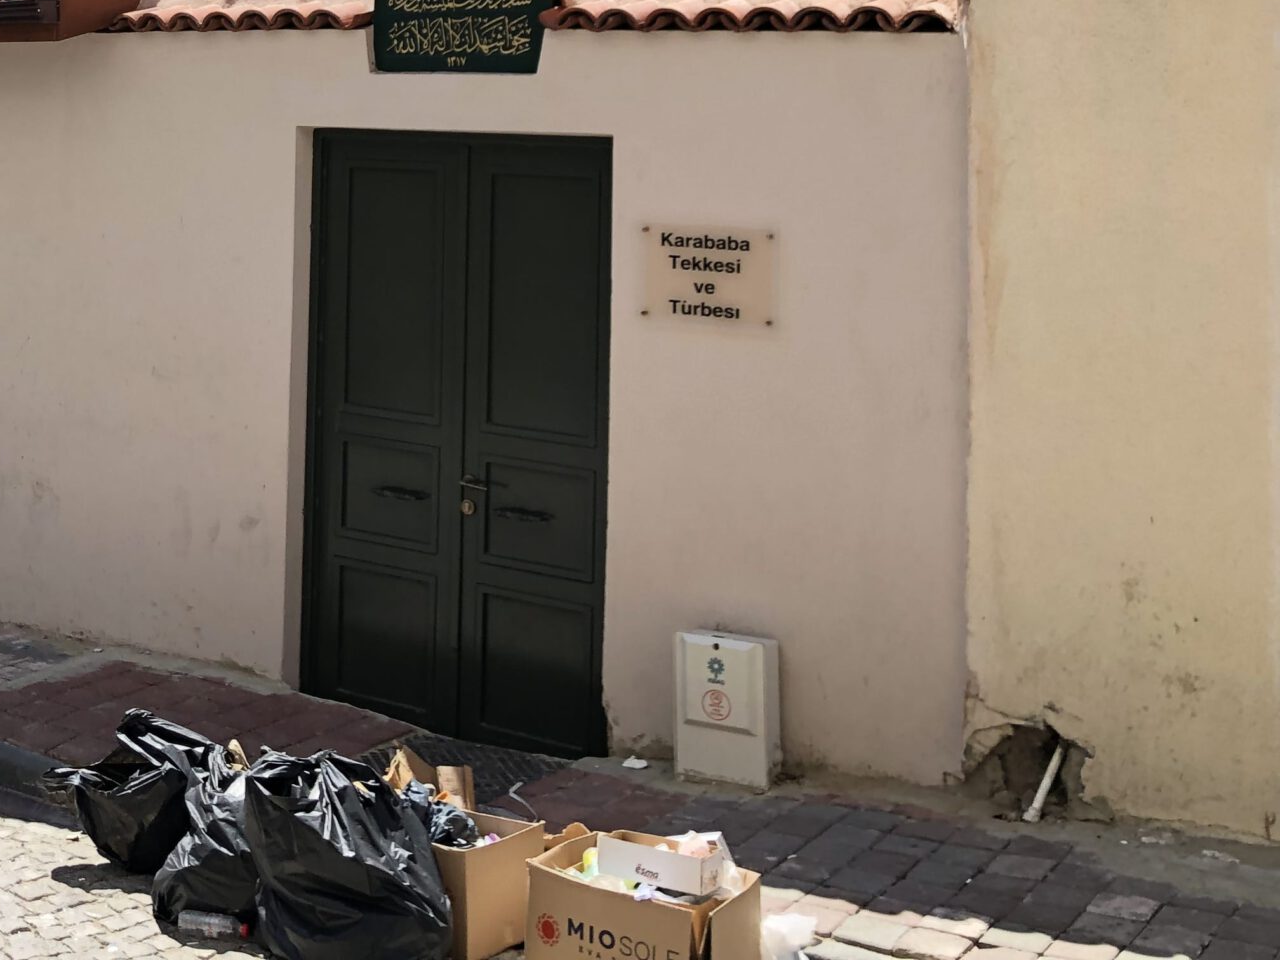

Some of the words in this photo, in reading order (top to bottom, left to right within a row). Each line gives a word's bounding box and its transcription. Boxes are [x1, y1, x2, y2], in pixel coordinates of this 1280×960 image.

[660, 232, 750, 251] Karababa
[668, 255, 741, 274] Tekkesi
[694, 282, 715, 294] ve
